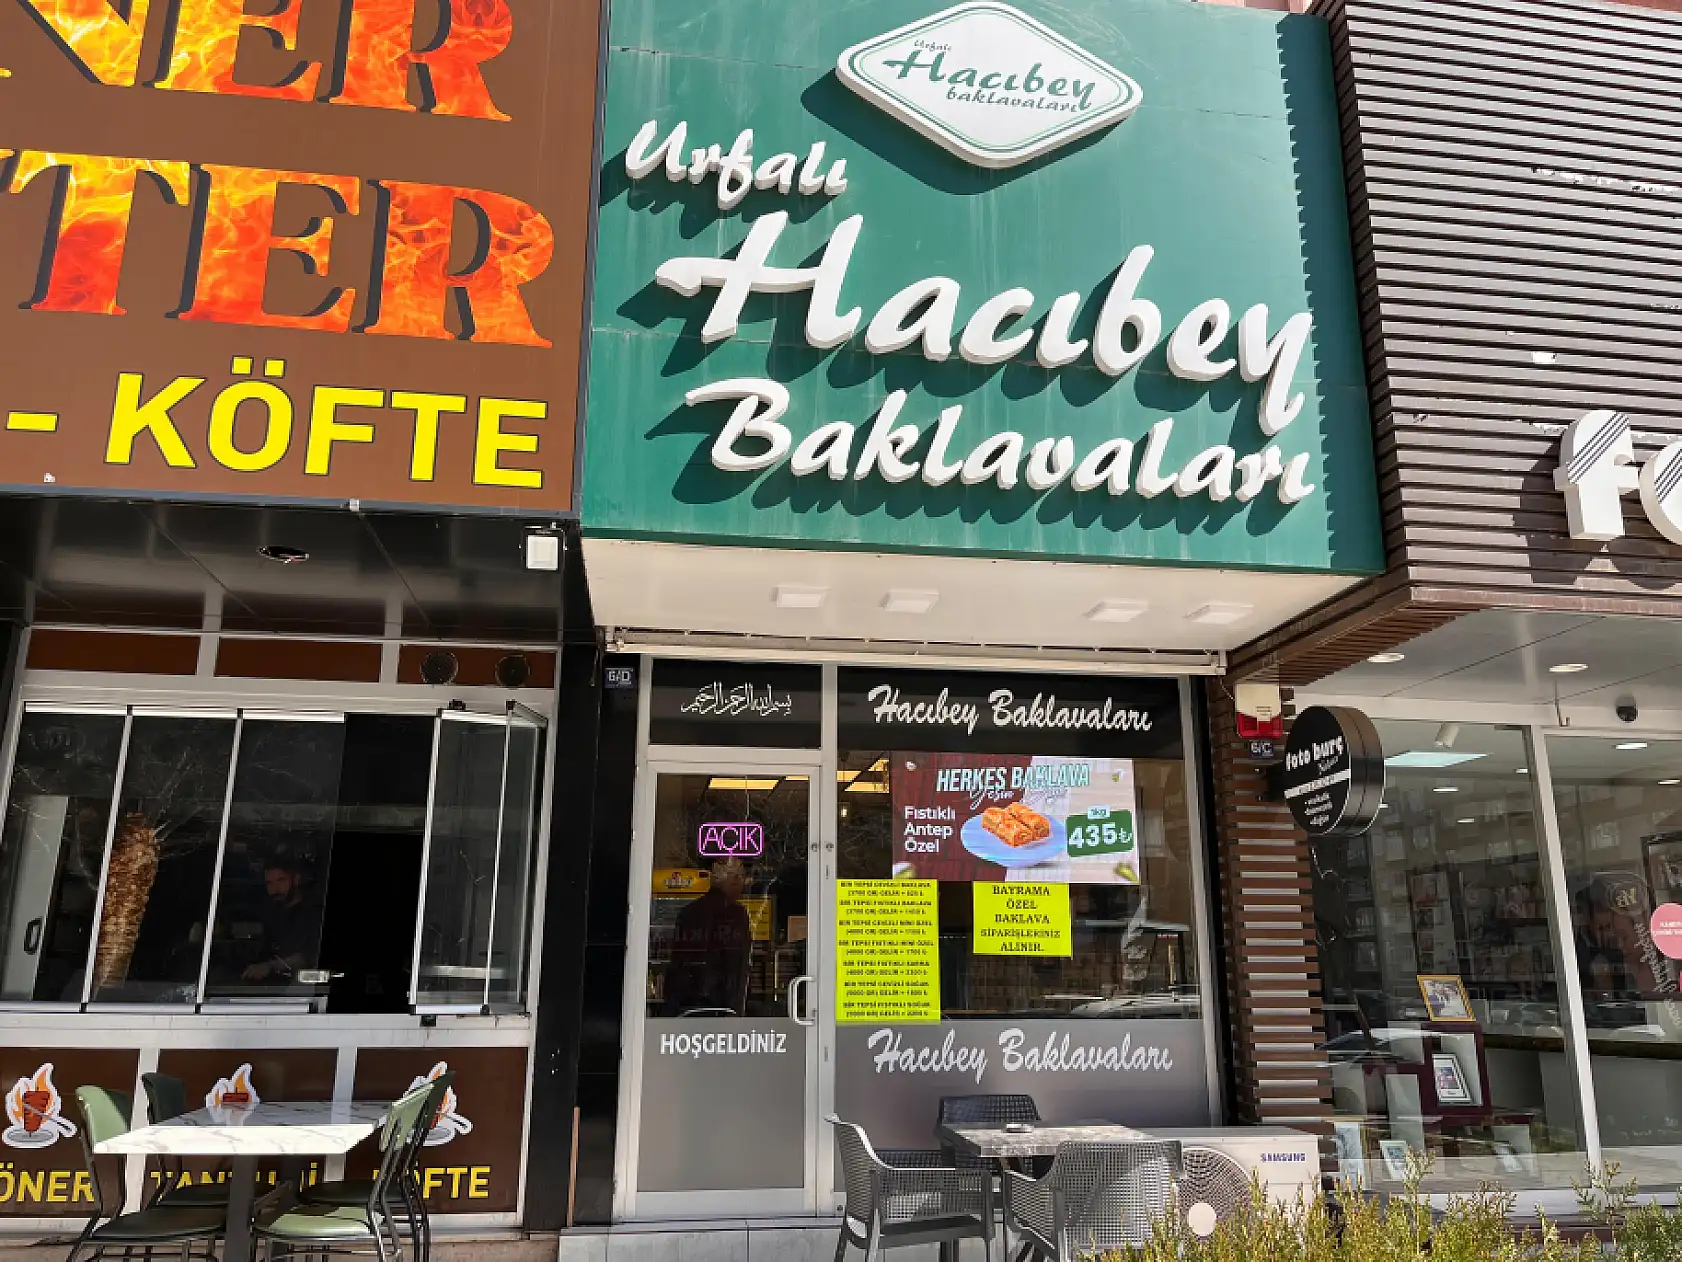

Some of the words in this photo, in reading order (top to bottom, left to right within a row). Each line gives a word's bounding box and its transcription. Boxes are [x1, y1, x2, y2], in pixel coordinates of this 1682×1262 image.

[882, 49, 1096, 111] Hacıbey
[946, 85, 1078, 113] baklavaları
[625, 120, 849, 210] Urfalı
[0, 148, 554, 348] TER
[655, 210, 1313, 436] Hacıbey
[104, 356, 549, 489] KÖFTE
[685, 376, 1315, 504] Baklavaları
[868, 683, 980, 736] Hacıbey
[988, 689, 1152, 731] Baklavaları
[937, 766, 1007, 791] HERKES
[1011, 763, 1091, 788] BAKLAVA
[904, 804, 956, 821] Fıstıklı
[702, 826, 760, 858] AÇIK
[904, 823, 953, 841] Antep
[904, 838, 940, 854] Özel
[992, 885, 1050, 896] BAYRAMA
[1006, 897, 1038, 910] ÖZEL
[995, 914, 1050, 924] BAKLAVA
[660, 1029, 787, 1059] HOŞGELDİNİZ
[868, 1027, 988, 1084] Hacıbey
[998, 1028, 1173, 1072] Baklavaları
[1260, 1152, 1306, 1162] SAMSUNG
